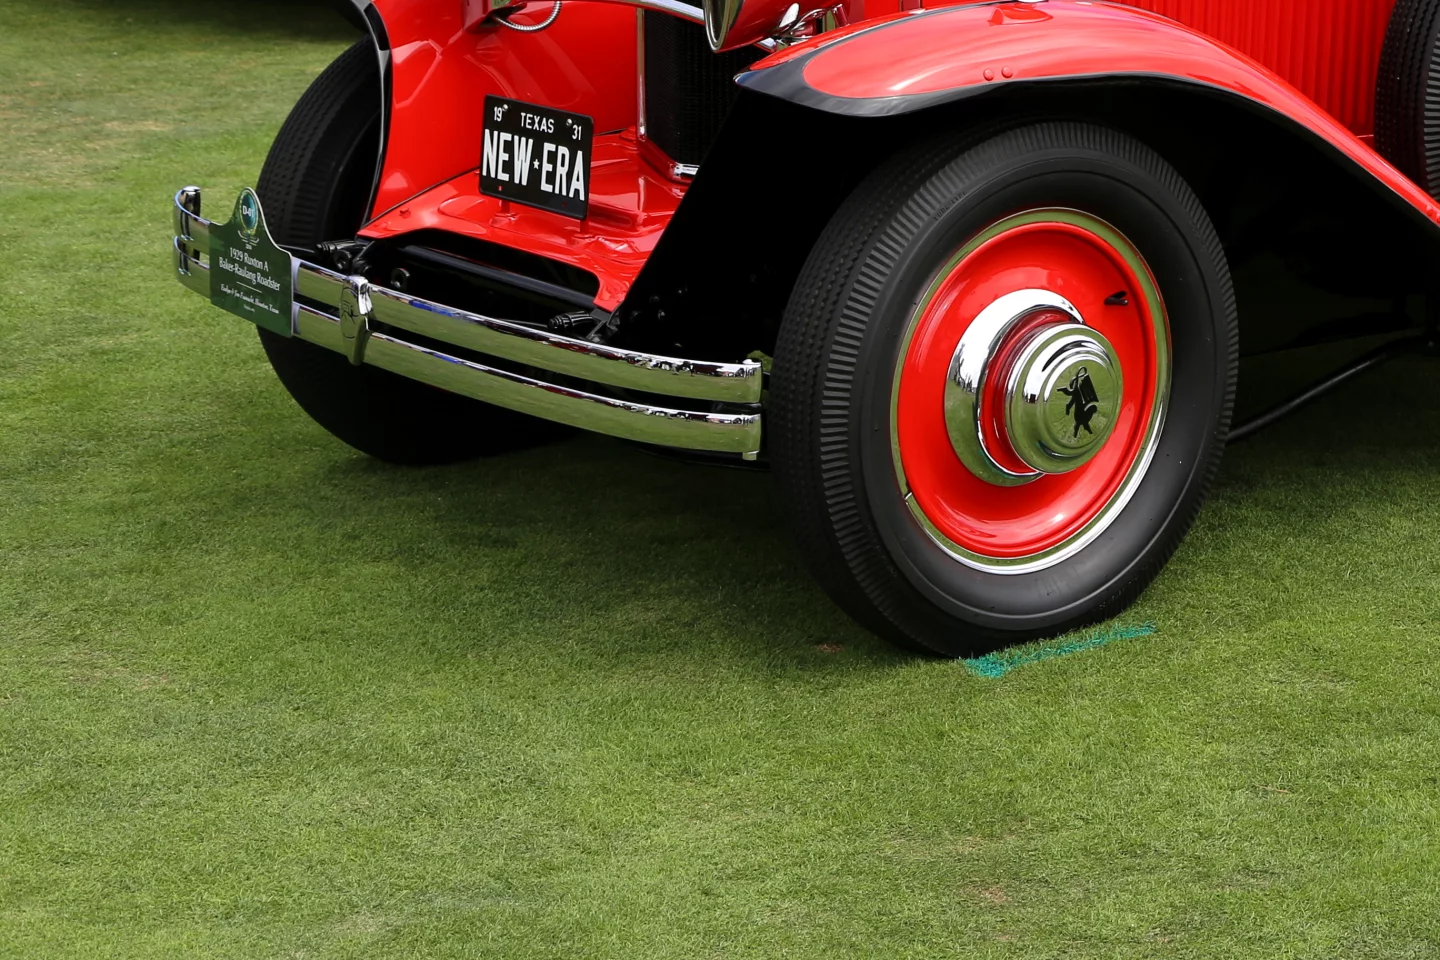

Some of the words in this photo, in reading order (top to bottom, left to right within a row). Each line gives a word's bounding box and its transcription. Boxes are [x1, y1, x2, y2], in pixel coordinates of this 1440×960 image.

[493, 106, 503, 122] 19
[520, 112, 555, 134] TEXAS
[571, 125, 582, 141] 31
[229, 247, 244, 262] 1929
[243, 252, 264, 270] Ruxton
[263, 260, 269, 272] A
[256, 272, 281, 291] Roadster
